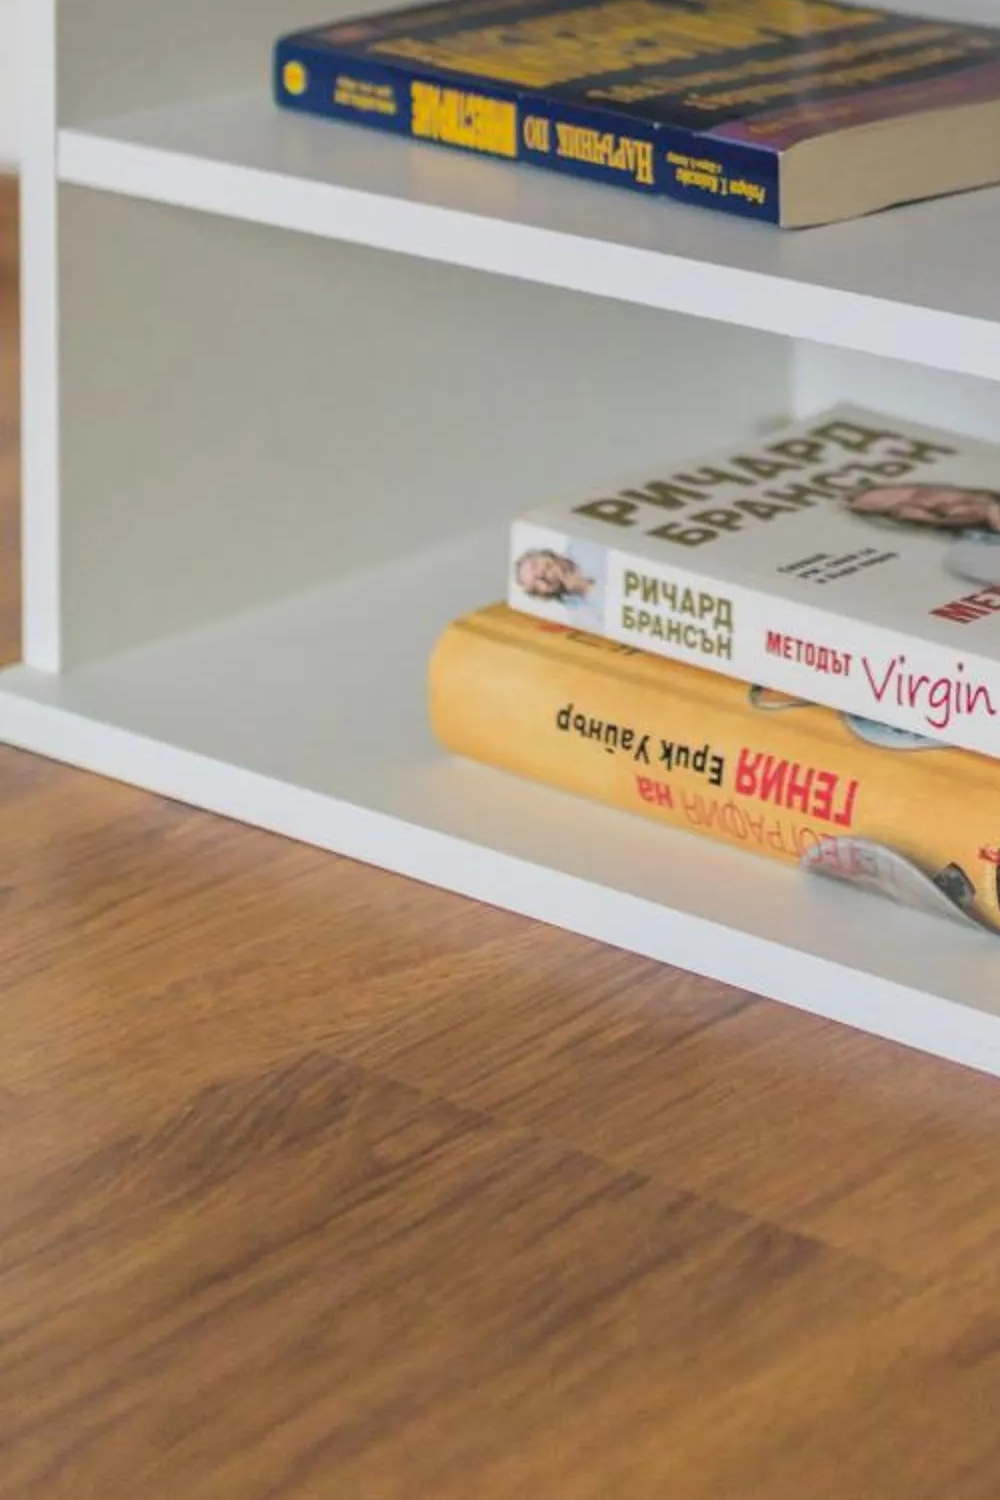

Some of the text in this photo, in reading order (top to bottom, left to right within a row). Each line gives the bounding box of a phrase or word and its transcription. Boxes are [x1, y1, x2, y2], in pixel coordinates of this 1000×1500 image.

[572, 420, 903, 527] РИЧАРД
[646, 437, 958, 547] БРАНСЪН
[622, 605, 733, 661] БРАНСЪН
[624, 570, 734, 633] РИЧАРД
[765, 630, 853, 676] МЕТОДЪТ
[861, 654, 997, 729] Virgin
[556, 702, 725, 788] Ерик Уайнър
[633, 771, 675, 809] на
[734, 746, 859, 829] ГЕНИЯ
